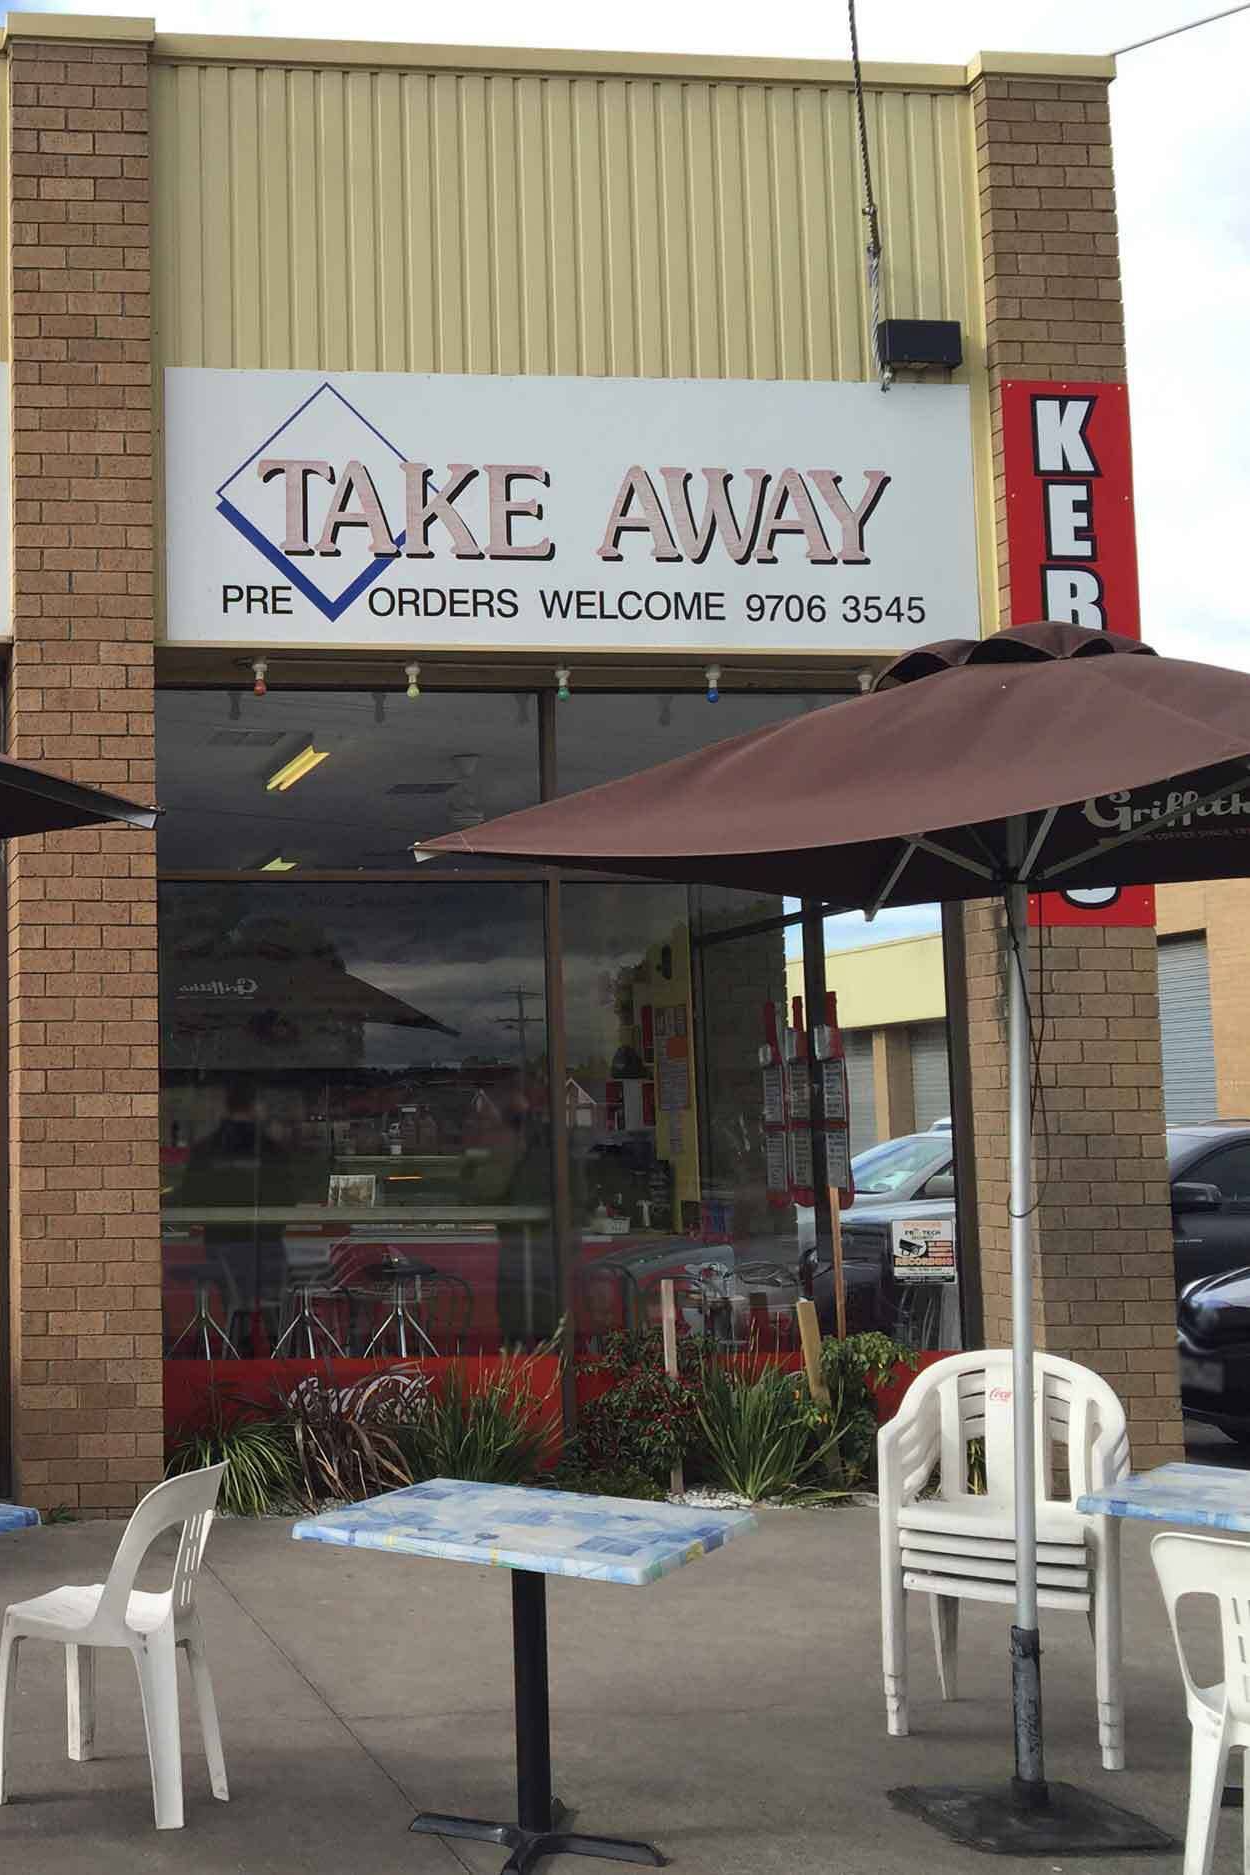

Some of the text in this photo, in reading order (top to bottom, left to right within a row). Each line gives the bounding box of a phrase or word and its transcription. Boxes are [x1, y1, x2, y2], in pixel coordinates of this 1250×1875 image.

[257, 459, 892, 566] TAKE AWAY
[222, 585, 927, 625] PRE ORDERS WELCOME 9706 3545
[1081, 790, 1250, 831] Griffith
